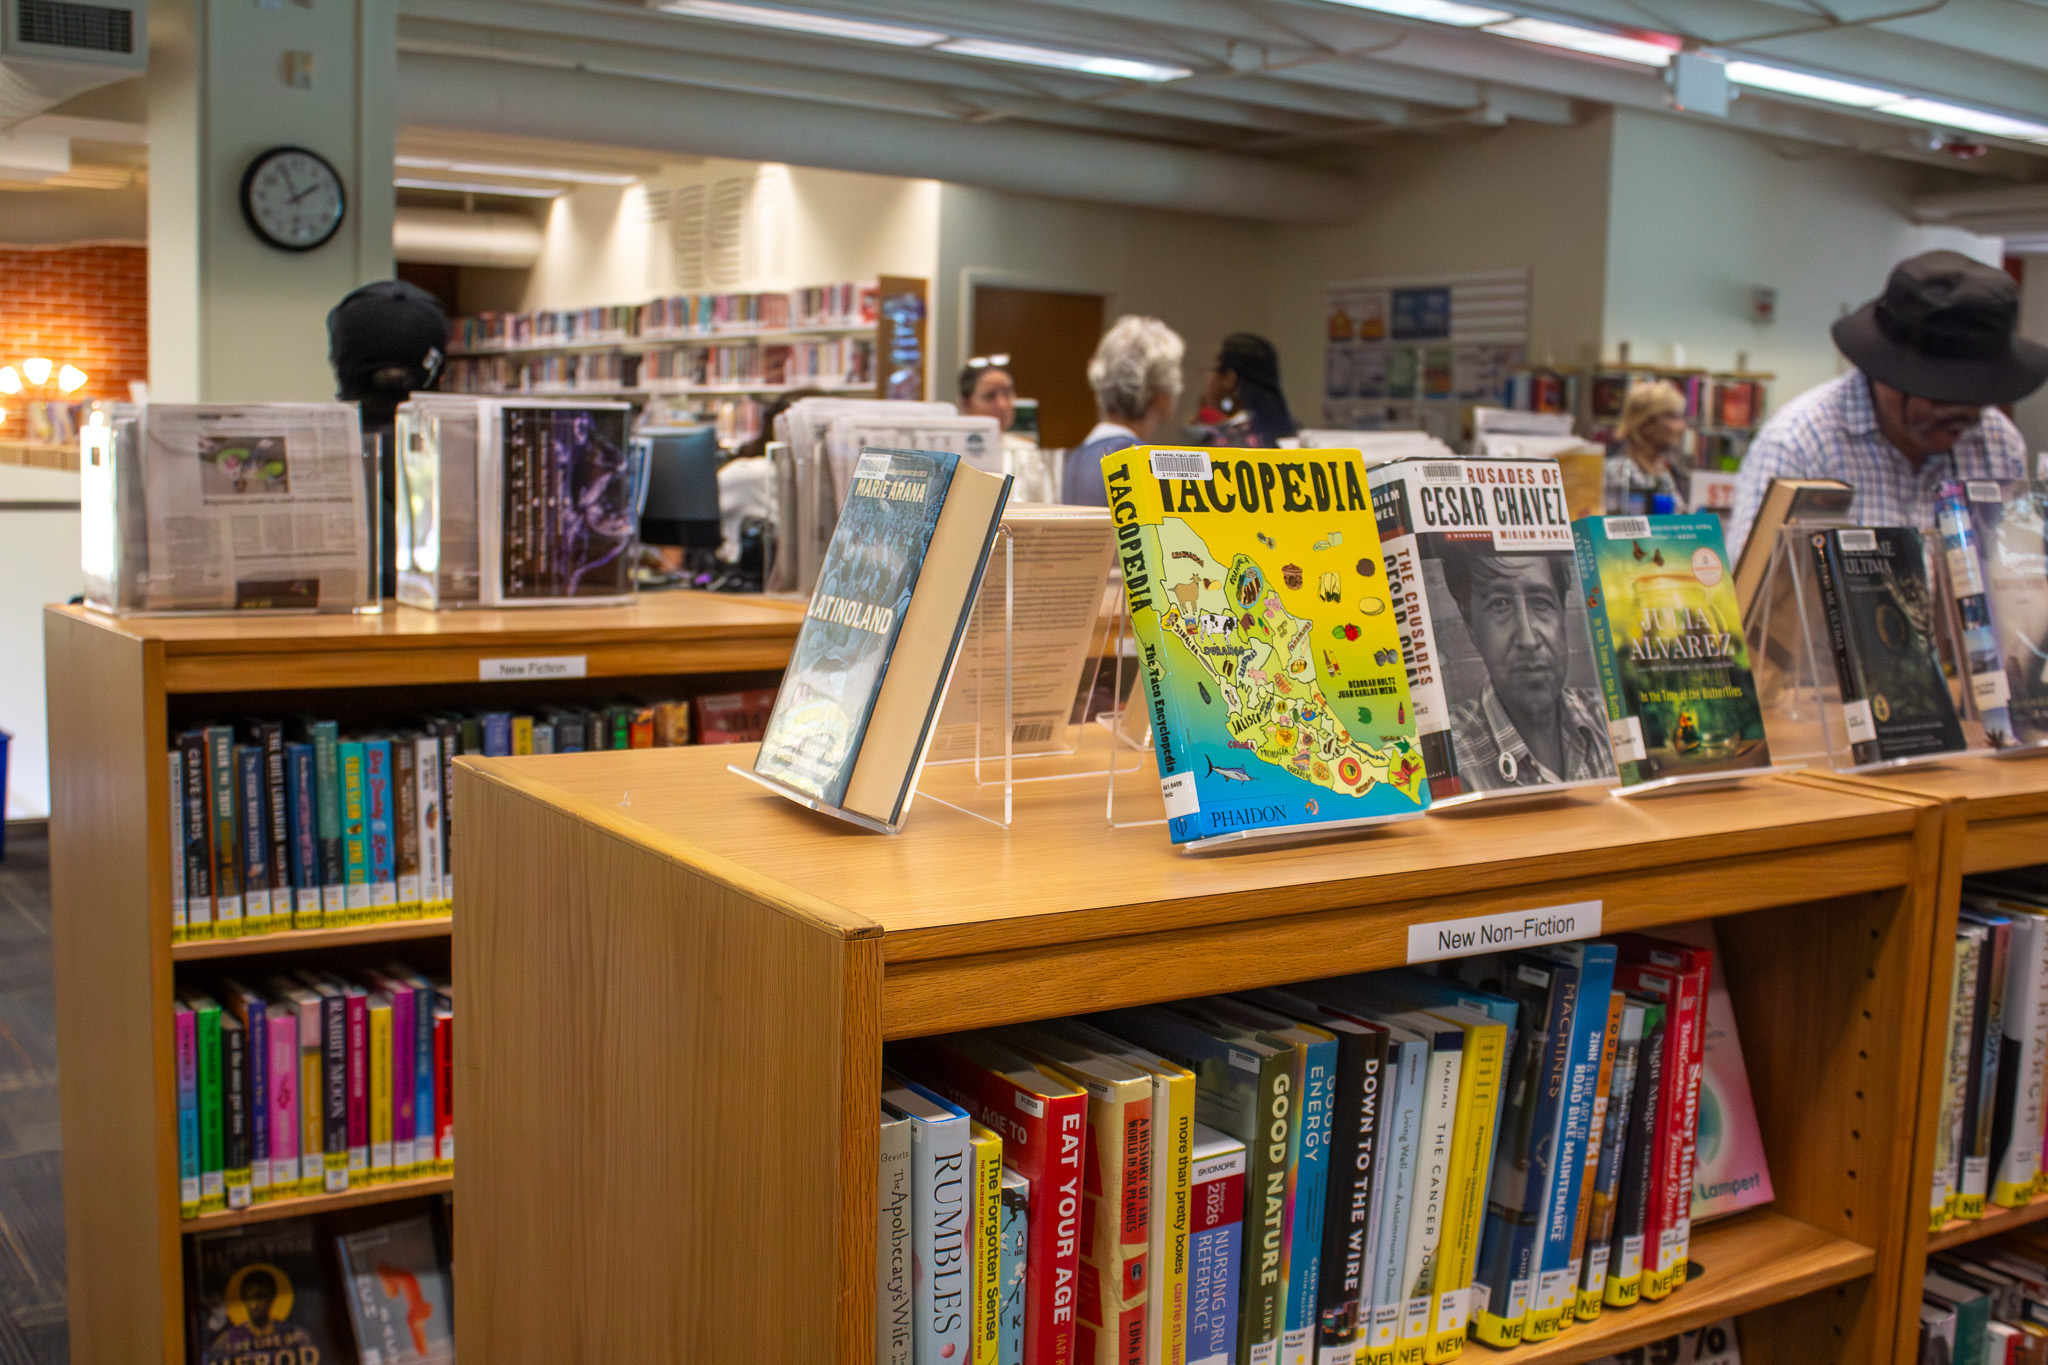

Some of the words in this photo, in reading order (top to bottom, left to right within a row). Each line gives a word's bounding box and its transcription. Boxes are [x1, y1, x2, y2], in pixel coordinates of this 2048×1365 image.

[854, 478, 890, 500] MARIE
[888, 482, 927, 503] ARANA
[1149, 460, 1367, 513] TACOPEDIA
[1467, 467, 1536, 485] RUSADES
[1542, 468, 1559, 485] OF
[1420, 486, 1489, 527] CESAR
[1492, 486, 1567, 526] CHAVEZ
[1107, 462, 1154, 614] TACOPEDIA
[1499, 530, 1537, 540] MIRIAM
[1540, 531, 1570, 540] PAWEL
[1397, 548, 1415, 583] THE
[1845, 559, 1892, 574] ULTIMA
[807, 592, 893, 635] LATINOLAND
[1640, 607, 1711, 631] JULIA
[1145, 643, 1157, 668] The
[1174, 624, 1199, 656] SINALOA
[1404, 591, 1433, 686] CRUSADES
[1631, 633, 1735, 661] ALVAREZ
[499, 663, 526, 676] New
[528, 662, 567, 675] Fiction
[1148, 668, 1161, 698] Taco
[1348, 678, 1376, 689] DÉBORAH
[1337, 688, 1354, 699] JUAN
[1355, 687, 1379, 697] CARLOS
[1380, 687, 1397, 696] MENA
[1650, 690, 1662, 703] the
[1662, 689, 1679, 701] Time
[1688, 687, 1701, 700] the
[1702, 686, 1742, 699] Butterflies
[1154, 698, 1175, 775] Encyclopedia
[1231, 713, 1262, 736] JALISCO
[188, 747, 202, 800] GRAVE
[189, 800, 204, 843] BIRDS
[1212, 804, 1287, 829] PHAIDON
[1438, 929, 1476, 951] New
[1480, 915, 1575, 944] Non-Fiction
[328, 999, 346, 1058] RABBIT
[1548, 983, 1577, 1099] MACHINES
[1587, 1030, 1601, 1063] ZINN
[329, 1061, 348, 1119] MOON
[1359, 1058, 1379, 1133] DOWN
[1440, 1060, 1452, 1109] NABHAN
[1570, 1063, 1586, 1103] ROAD
[1582, 1074, 1596, 1099] THE
[1138, 1118, 1149, 1127] A
[1269, 1072, 1291, 1164] GOOD
[1304, 1065, 1324, 1162] ENERGY
[1323, 1074, 1336, 1145] GOOD
[1565, 1103, 1581, 1140] BIKE
[1579, 1100, 1592, 1127] ART
[1682, 1063, 1701, 1146] Super
[982, 1106, 1006, 1135] AGE
[1009, 1121, 1028, 1145] TO
[1060, 1112, 1081, 1169] EAT
[1127, 1119, 1139, 1156] WORLD
[1178, 1116, 1189, 1154] more
[1397, 1109, 1414, 1144] Living
[1434, 1122, 1447, 1155] THE
[1585, 1096, 1609, 1167] Bark!
[988, 1153, 1001, 1190] The
[1127, 1156, 1138, 1169] IN
[1138, 1128, 1150, 1182] HISTORY
[1177, 1156, 1190, 1189] than
[1198, 1160, 1237, 1177] SKIDMORE
[1355, 1138, 1373, 1171] TO
[1397, 1144, 1411, 1170] Well
[892, 1168, 905, 1193] The
[1126, 1170, 1138, 1191] SIX
[1138, 1183, 1149, 1197] OF
[1550, 1141, 1575, 1242] MAINTENANCE
[1700, 1171, 1761, 1200] Lampert
[979, 1207, 985, 1215] OF
[1056, 1176, 1078, 1259] YOUR
[1125, 1192, 1137, 1234] PLAGUES
[1136, 1197, 1149, 1230] THE
[1174, 1190, 1189, 1231] pretty
[1206, 1183, 1221, 1226] 2026
[1351, 1176, 1369, 1224] THE
[1425, 1165, 1442, 1236] CANCER
[881, 1191, 910, 1300] Apothecary's
[932, 1148, 963, 1335] RUMBLES
[985, 1193, 1001, 1284] Forgotten
[1260, 1170, 1287, 1287] NATURE
[1388, 1192, 1405, 1265] Autoimmune
[1014, 1249, 1025, 1258] life
[1174, 1233, 1187, 1275] boxes
[1211, 1229, 1230, 1311] NURSING
[1344, 1228, 1363, 1292] WIRE
[1053, 1267, 1074, 1326] AGE
[1172, 1282, 1183, 1318] carrie
[1194, 1235, 1213, 1336] REFERENCE
[891, 1298, 911, 1350] Wife
[985, 1286, 999, 1343] Sense
[1262, 1295, 1274, 1330] KATHY
[1055, 1333, 1067, 1356] IAN
[1128, 1319, 1141, 1353] EDNA
